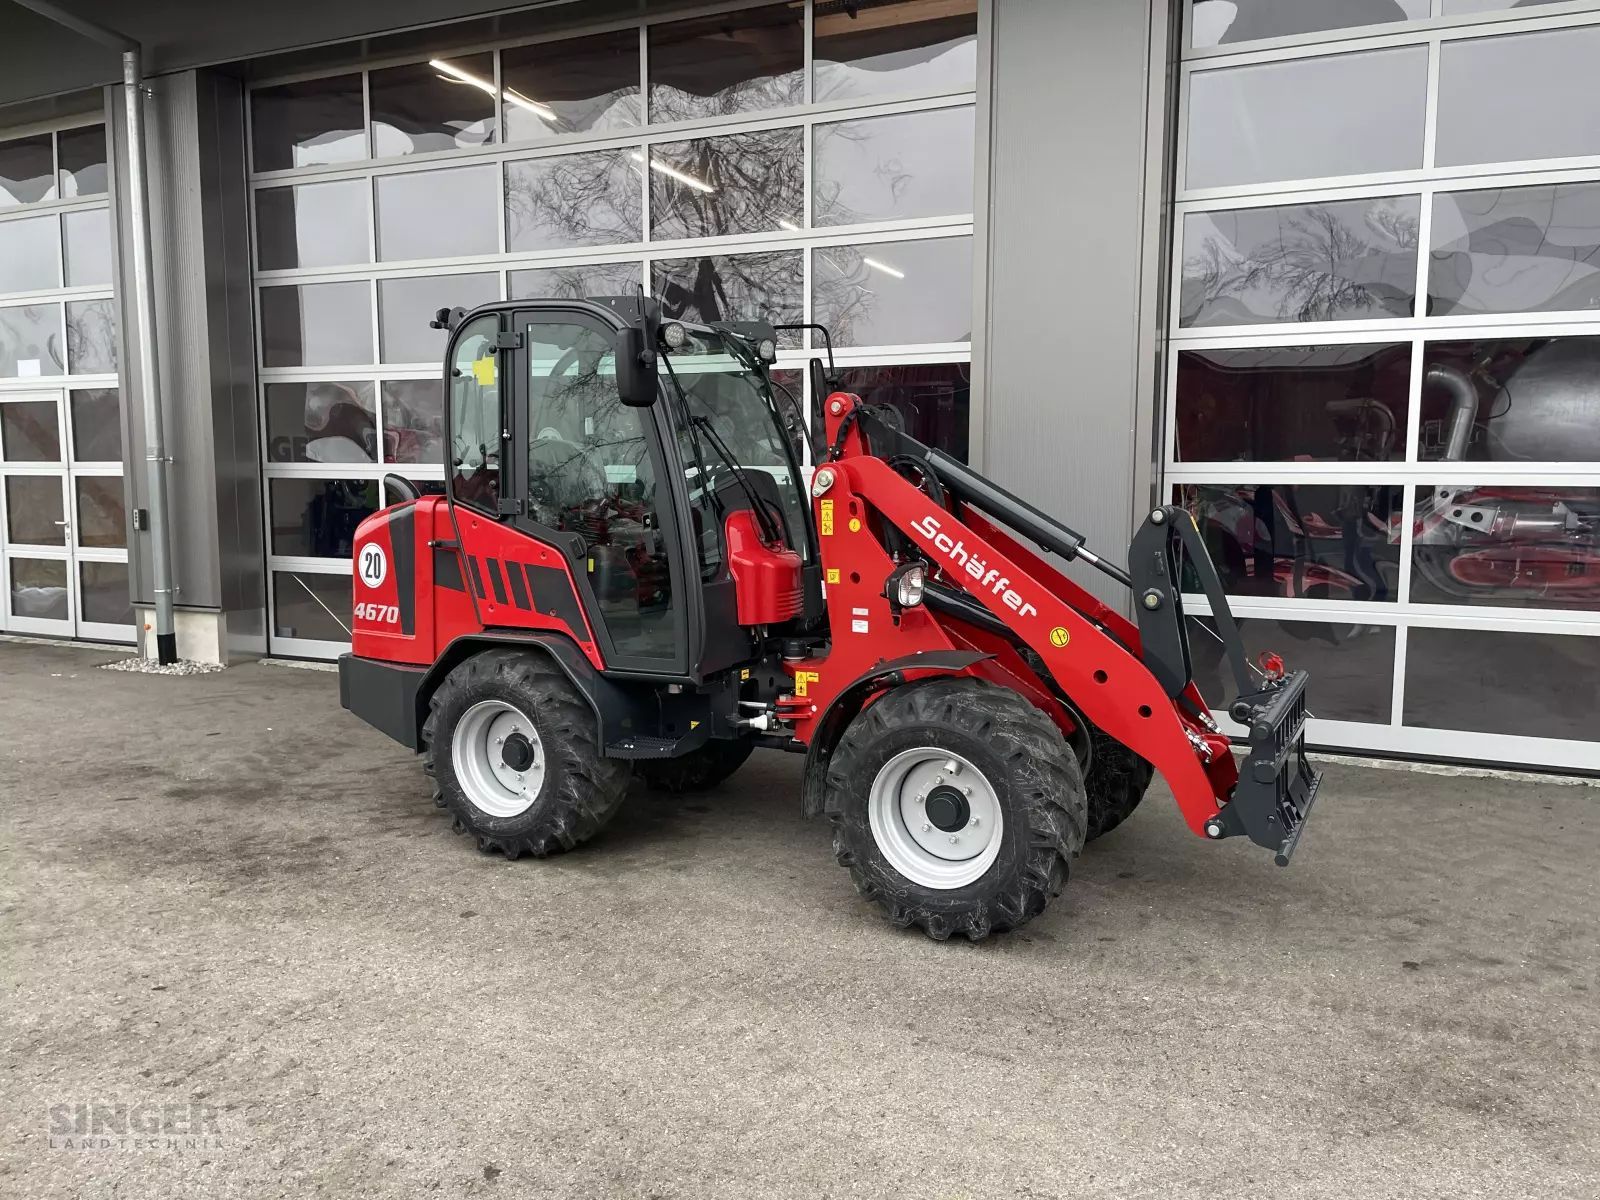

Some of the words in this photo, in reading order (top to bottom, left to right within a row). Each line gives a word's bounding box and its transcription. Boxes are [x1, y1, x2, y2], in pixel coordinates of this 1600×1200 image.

[364, 551, 381, 580] 20
[910, 515, 1038, 618] Schäffer
[353, 602, 399, 624] 4670
